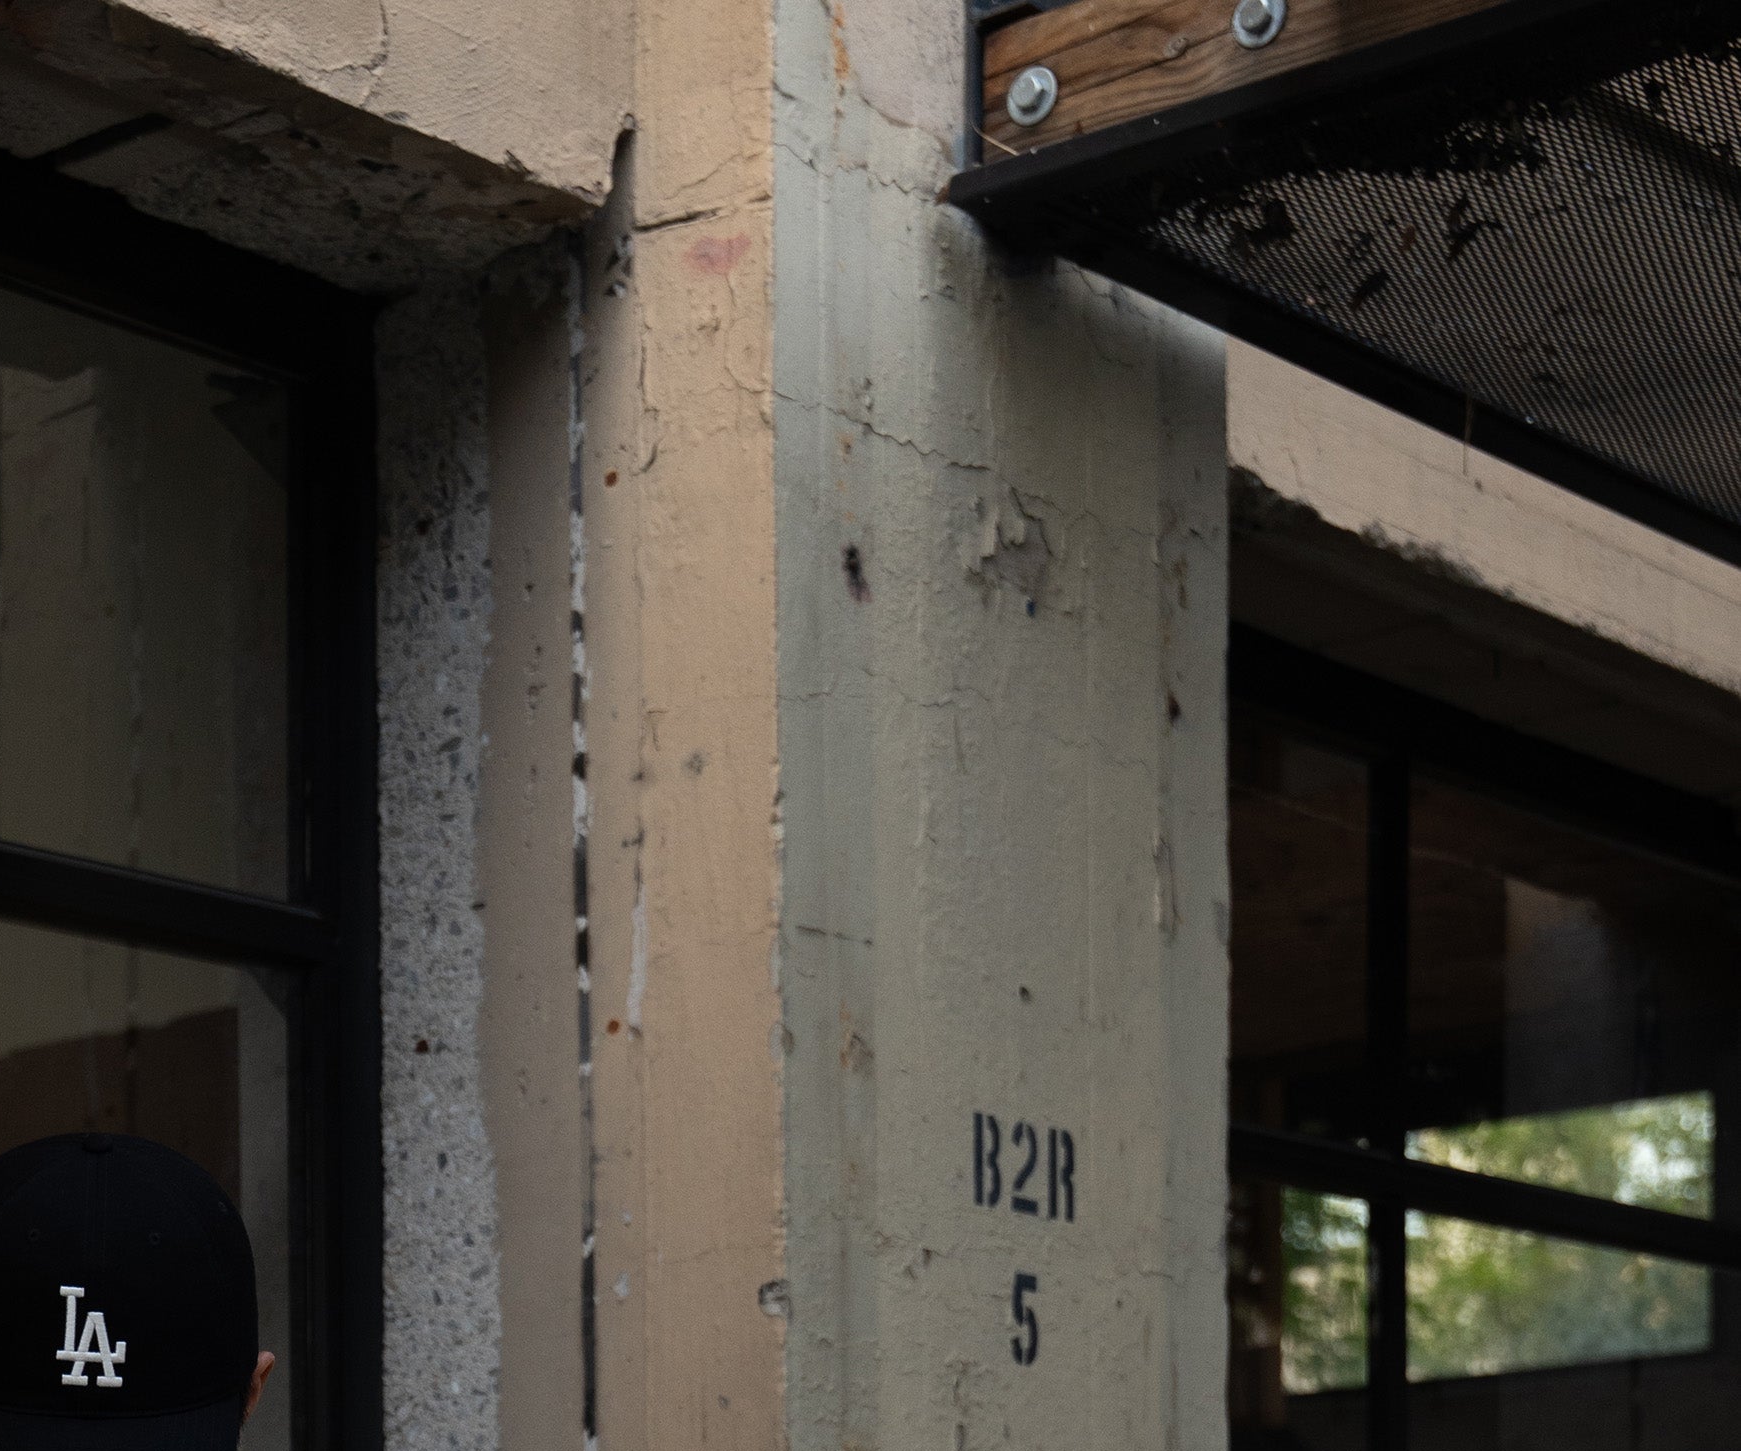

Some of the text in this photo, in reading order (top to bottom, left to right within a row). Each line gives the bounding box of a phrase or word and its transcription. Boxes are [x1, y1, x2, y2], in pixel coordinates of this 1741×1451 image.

[973, 1112, 1074, 1223] B2R
[56, 1285, 126, 1387] LA
[1011, 1270, 1038, 1366] 5
